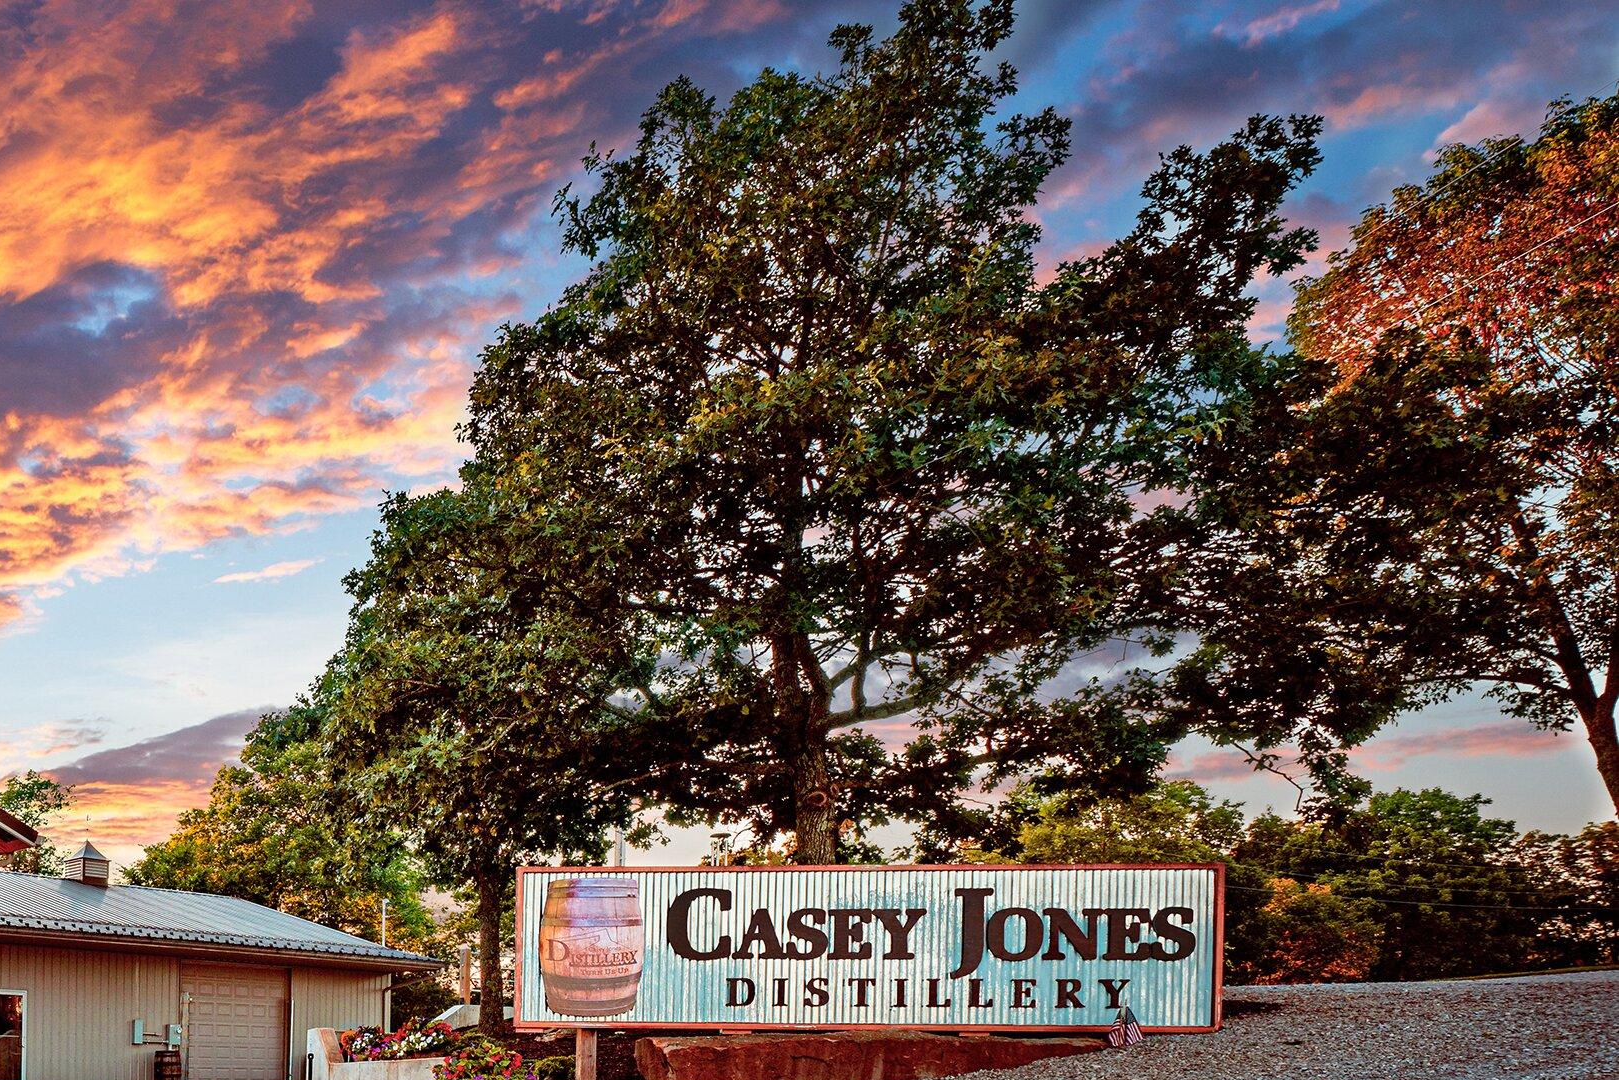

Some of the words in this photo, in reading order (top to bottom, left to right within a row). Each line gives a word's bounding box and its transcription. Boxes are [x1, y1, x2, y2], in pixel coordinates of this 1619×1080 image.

[666, 887, 928, 961] CASEY
[948, 887, 1197, 979] JONES
[544, 938, 639, 965] DISTILLERY
[725, 977, 1131, 1009] DISTILLERY
